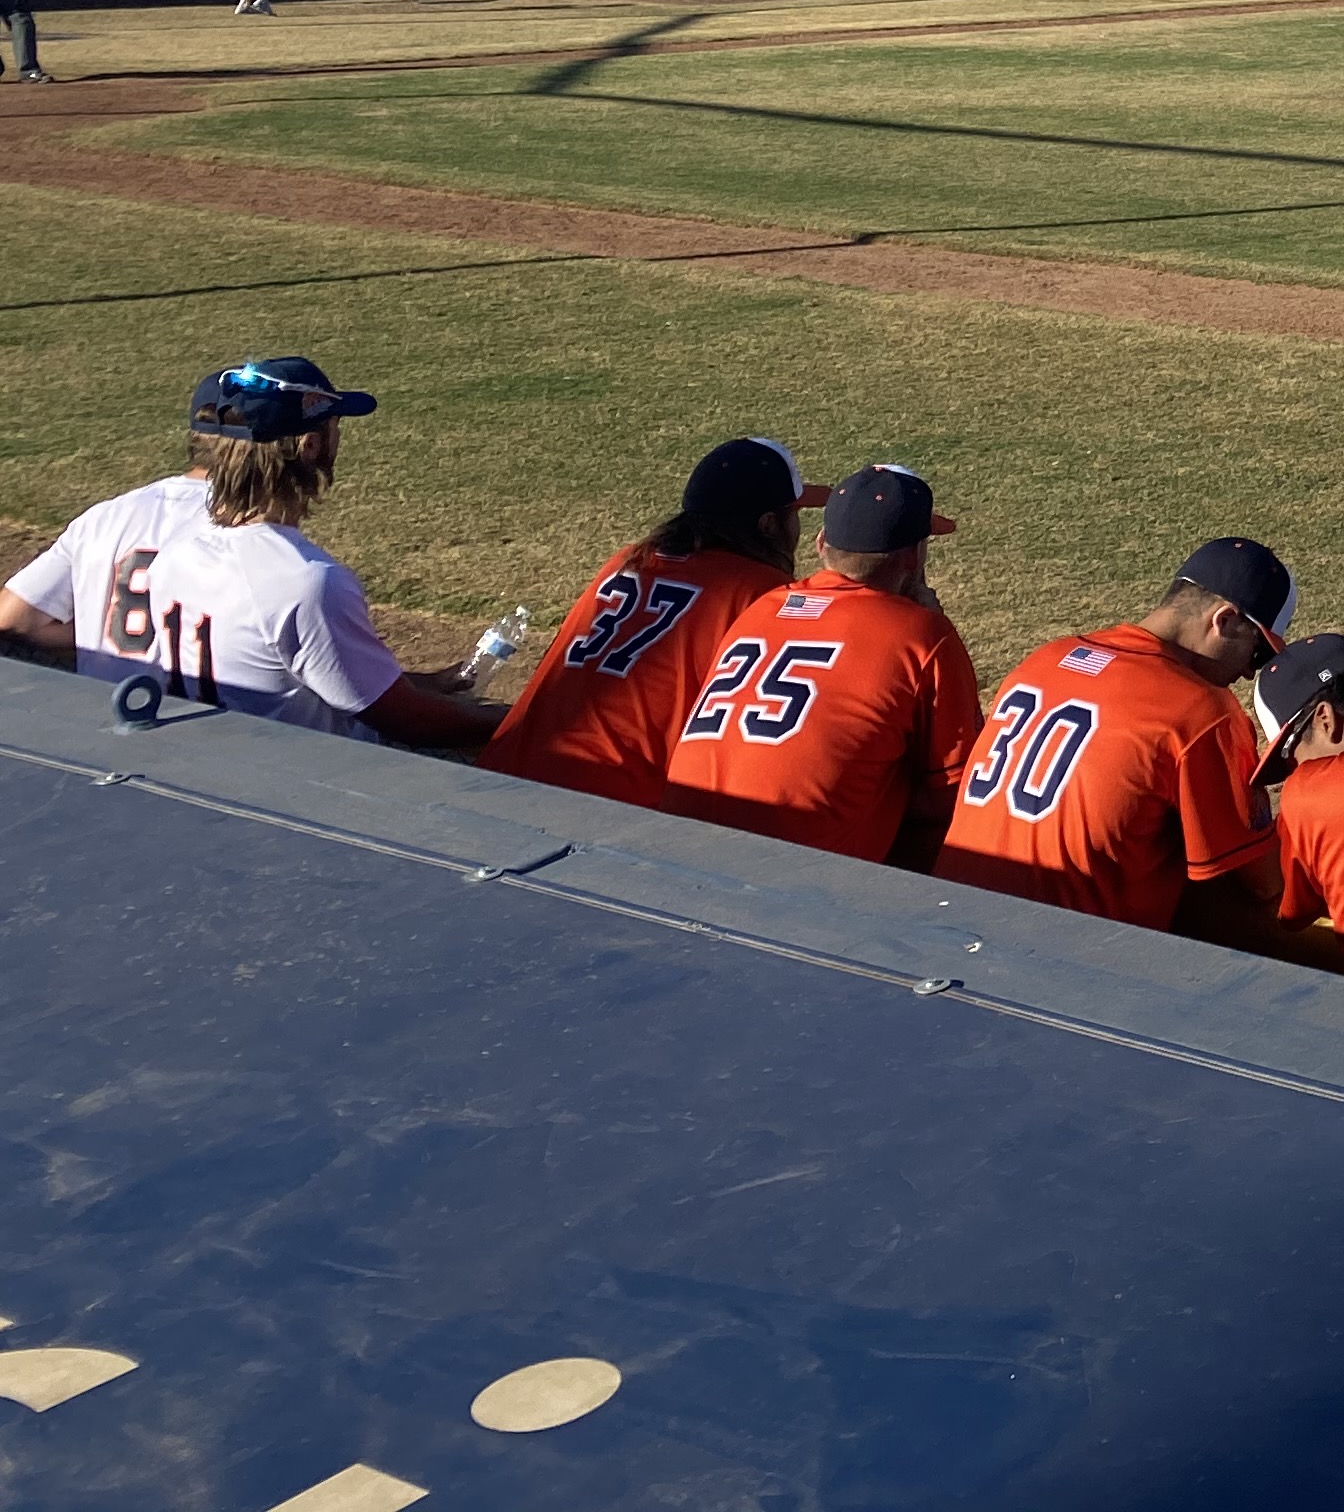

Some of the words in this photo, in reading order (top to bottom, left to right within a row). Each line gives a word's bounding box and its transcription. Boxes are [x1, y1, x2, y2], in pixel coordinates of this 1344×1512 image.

[162, 600, 221, 706] 11
[564, 569, 704, 679] 37
[680, 638, 844, 746] 25
[963, 682, 1100, 824] 30
